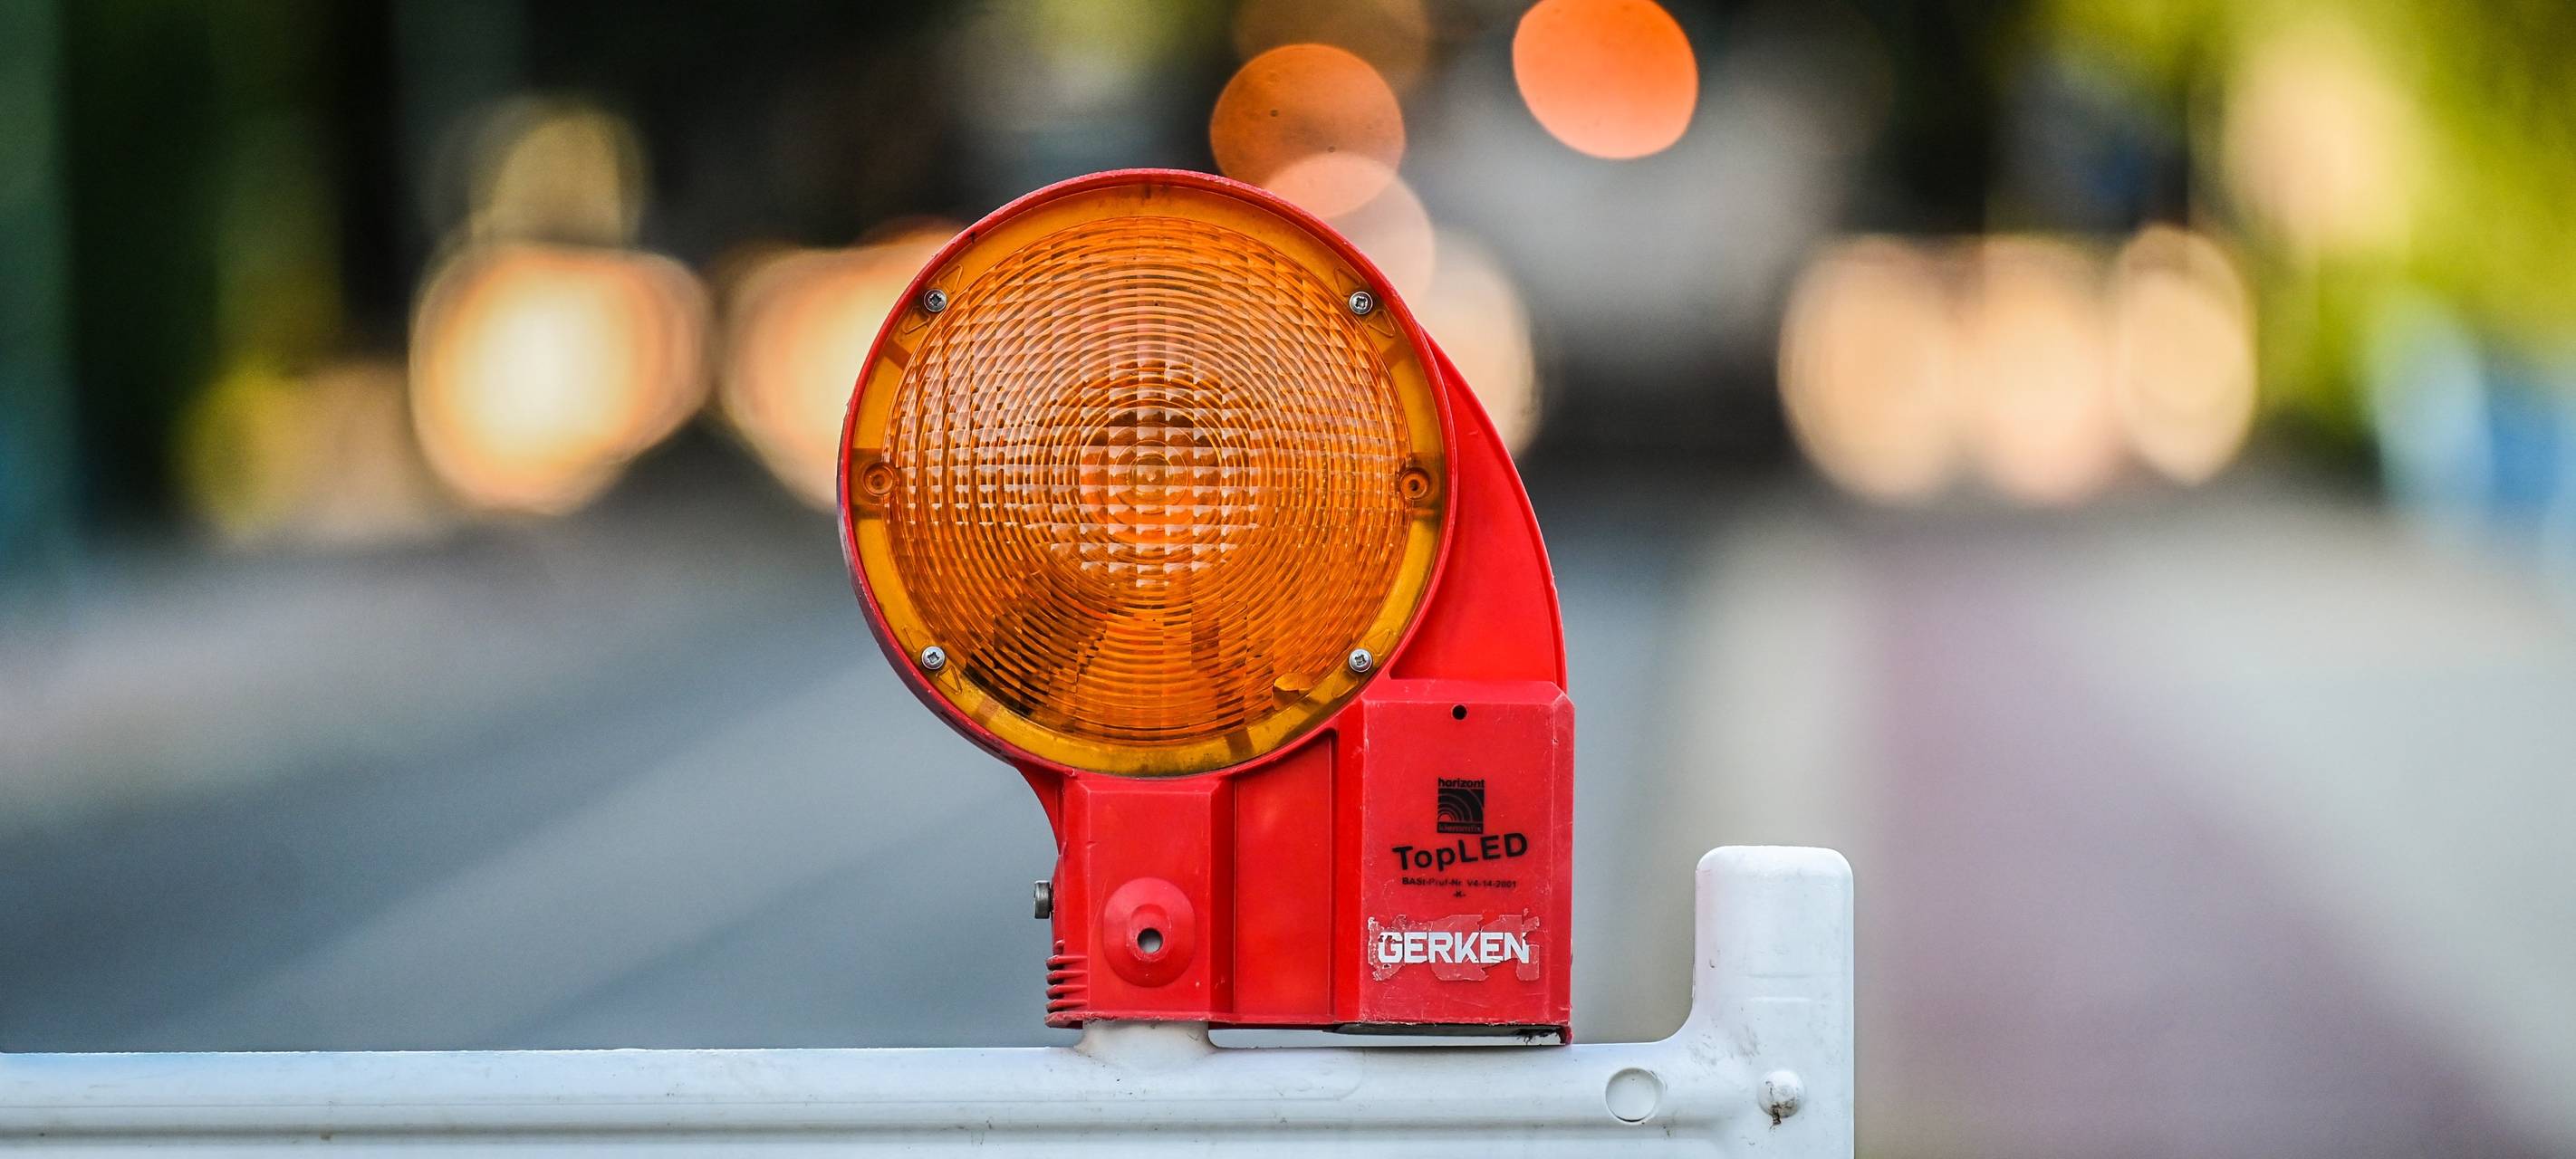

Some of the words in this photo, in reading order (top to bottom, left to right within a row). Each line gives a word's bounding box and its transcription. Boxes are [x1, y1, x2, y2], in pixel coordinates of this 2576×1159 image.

[1437, 778, 1485, 788] horizont
[1392, 832, 1529, 872] TopLED
[1377, 932, 1531, 964] GERKEN
